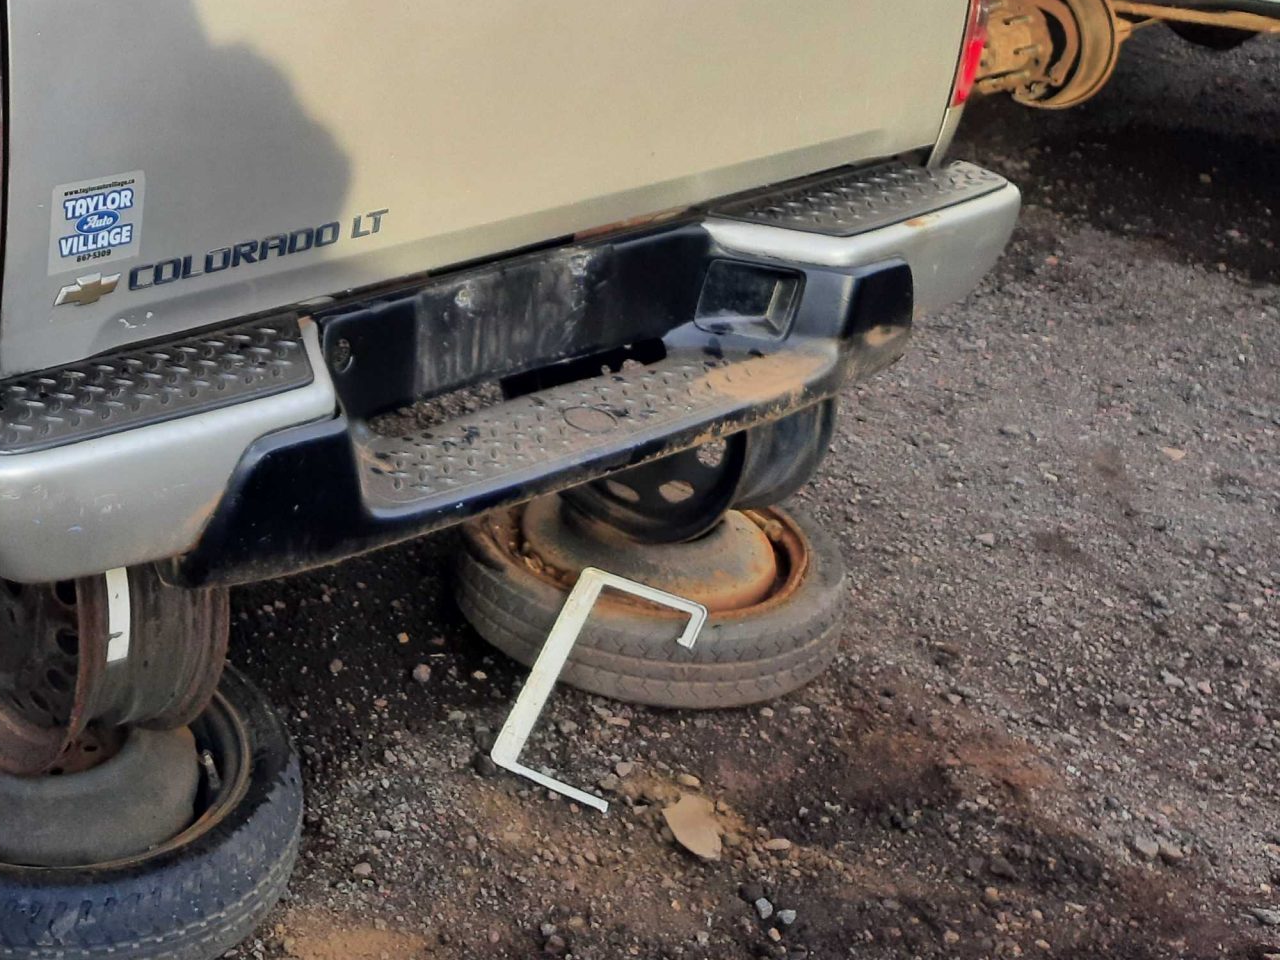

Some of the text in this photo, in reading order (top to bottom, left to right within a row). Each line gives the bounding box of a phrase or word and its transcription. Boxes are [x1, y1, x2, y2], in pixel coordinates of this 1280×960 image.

[64, 188, 133, 220] TAYLOR
[83, 214, 113, 230] Auto
[59, 223, 133, 258] VILLAGE
[128, 208, 389, 290] COLORADO LT
